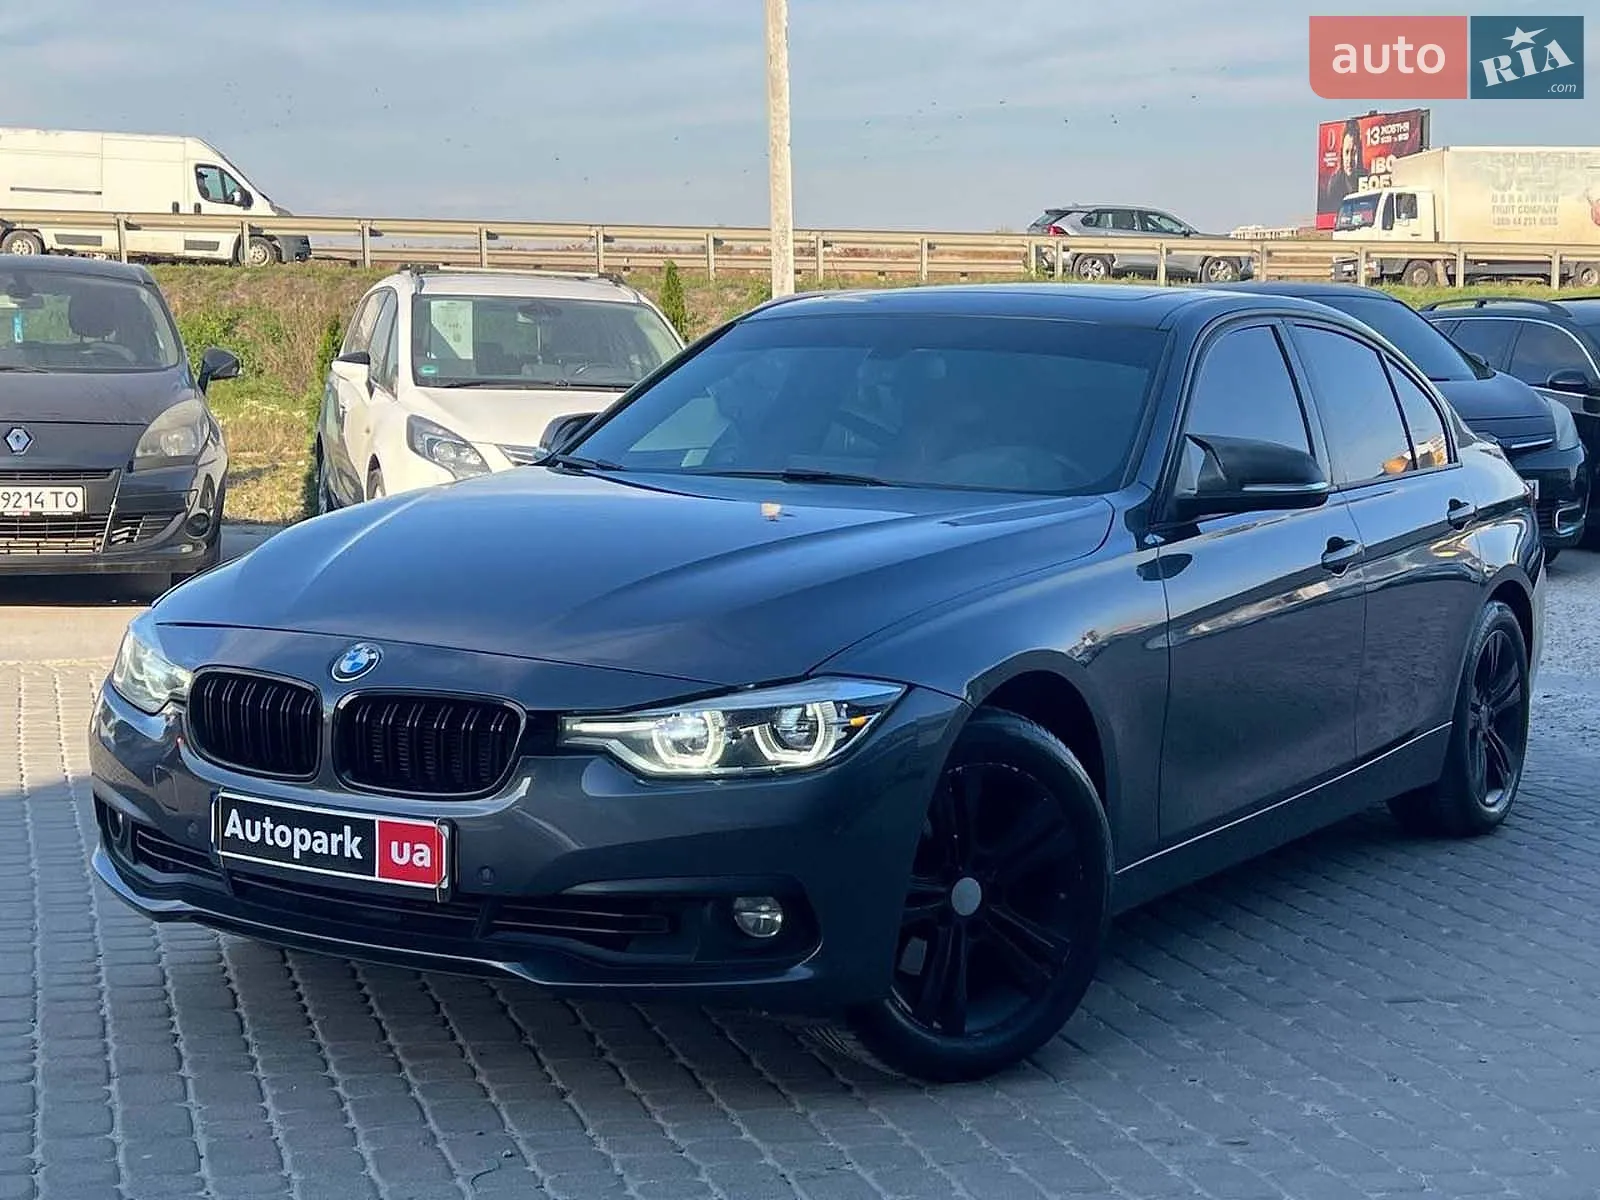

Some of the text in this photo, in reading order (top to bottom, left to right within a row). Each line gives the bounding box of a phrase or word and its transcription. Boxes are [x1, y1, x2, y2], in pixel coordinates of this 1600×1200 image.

[1366, 126, 1380, 147] 13
[1, 491, 78, 508] 9214 TO
[224, 808, 431, 868] Autopark ua
